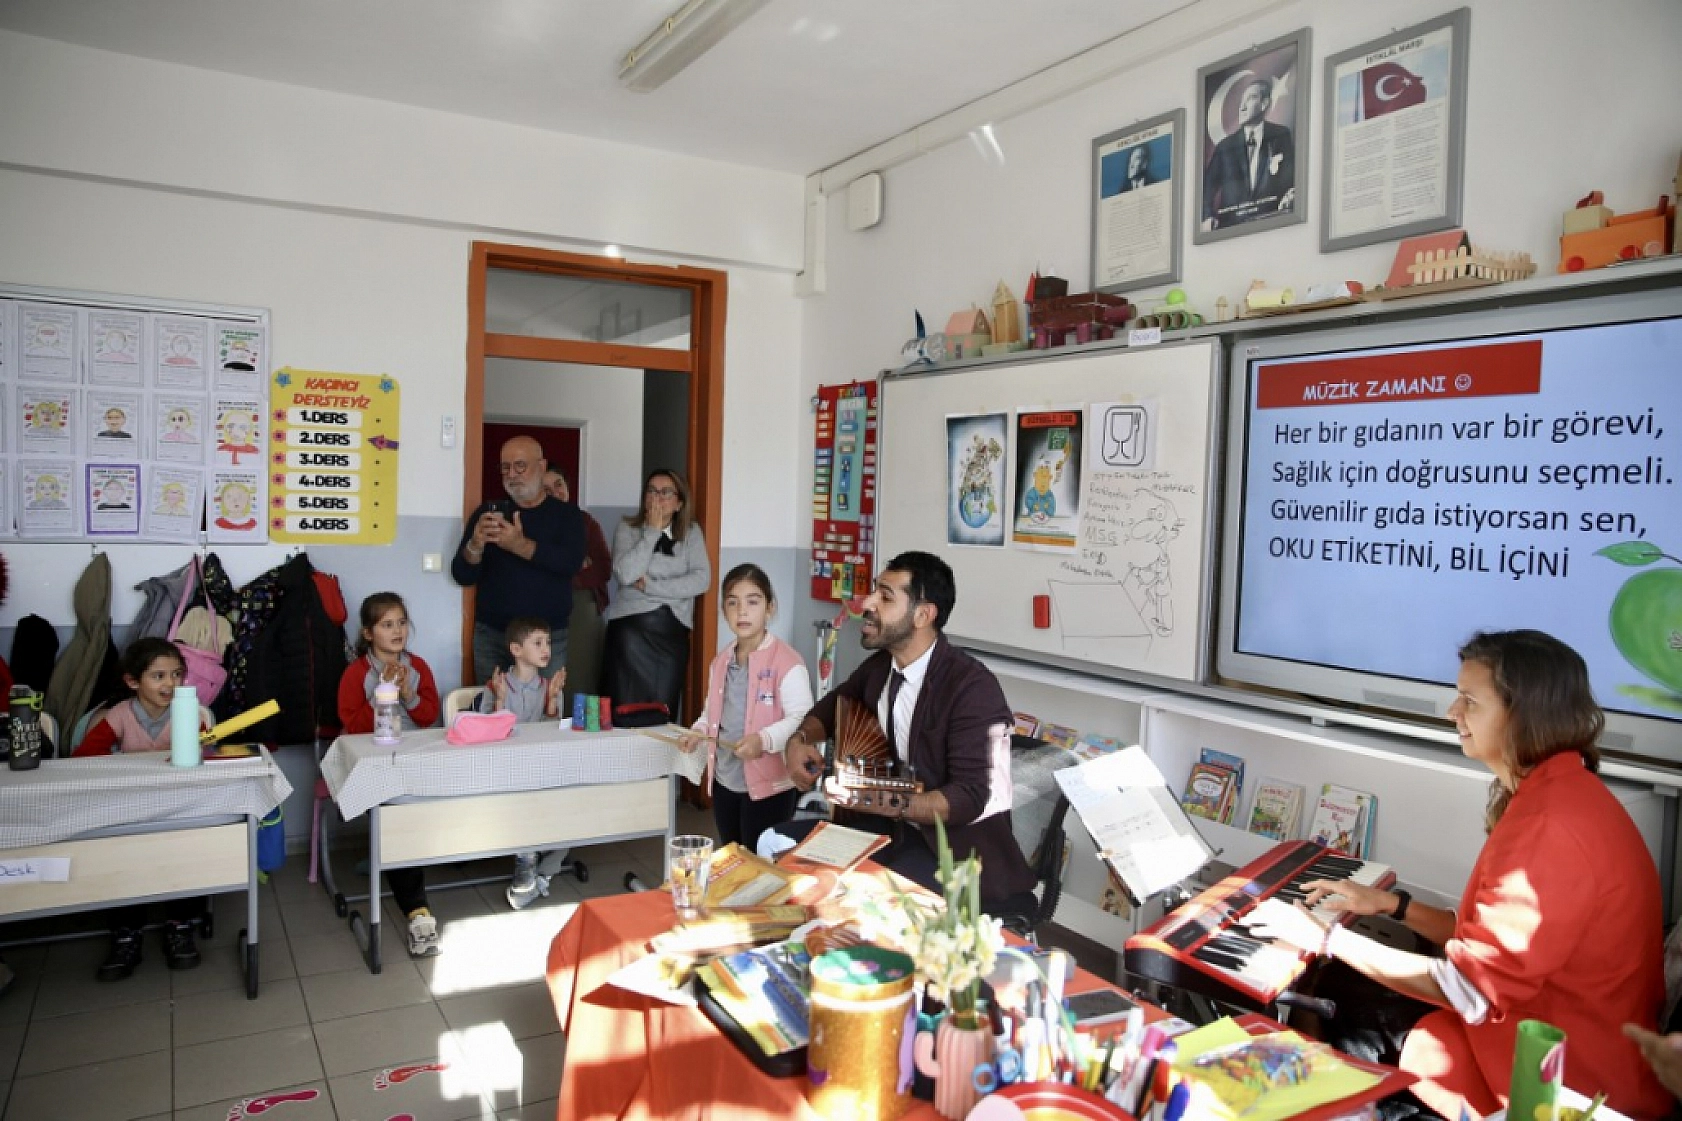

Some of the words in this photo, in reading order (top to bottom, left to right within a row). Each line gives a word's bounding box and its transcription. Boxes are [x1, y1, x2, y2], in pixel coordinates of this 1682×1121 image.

[305, 378, 360, 393] KAÇINCI
[1303, 379, 1358, 400] MÜZİK
[1366, 376, 1445, 397] ZAMANI
[293, 393, 371, 409] DERSTEYİZ
[300, 410, 348, 424] 1.DERS
[1275, 423, 1311, 444] Her
[1319, 421, 1347, 443] bir
[1353, 418, 1442, 448] gıdanın
[1452, 421, 1494, 440] var
[1504, 413, 1543, 438] bir
[1551, 407, 1663, 443] görevi,
[299, 432, 350, 446] 2.DERS
[299, 453, 350, 467] 3.DERS
[1273, 461, 1332, 487] Sağlık
[1340, 461, 1378, 487] için
[1386, 459, 1527, 489] doğrusunu
[1538, 456, 1672, 490] seçmeli.
[298, 475, 351, 488] 4.DERS
[298, 497, 349, 509] 5.DERS
[299, 518, 349, 531] 6.DERS
[1271, 500, 1368, 523] Güvenilir
[1374, 500, 1424, 529] gıda
[1435, 502, 1568, 533] istiyorsan
[1579, 513, 1646, 538] sen,
[1270, 537, 1314, 559] OKU
[1322, 536, 1440, 572] ETİKETİNİ,
[1451, 542, 1489, 572] BİL
[1499, 544, 1569, 580] İÇİNİ
